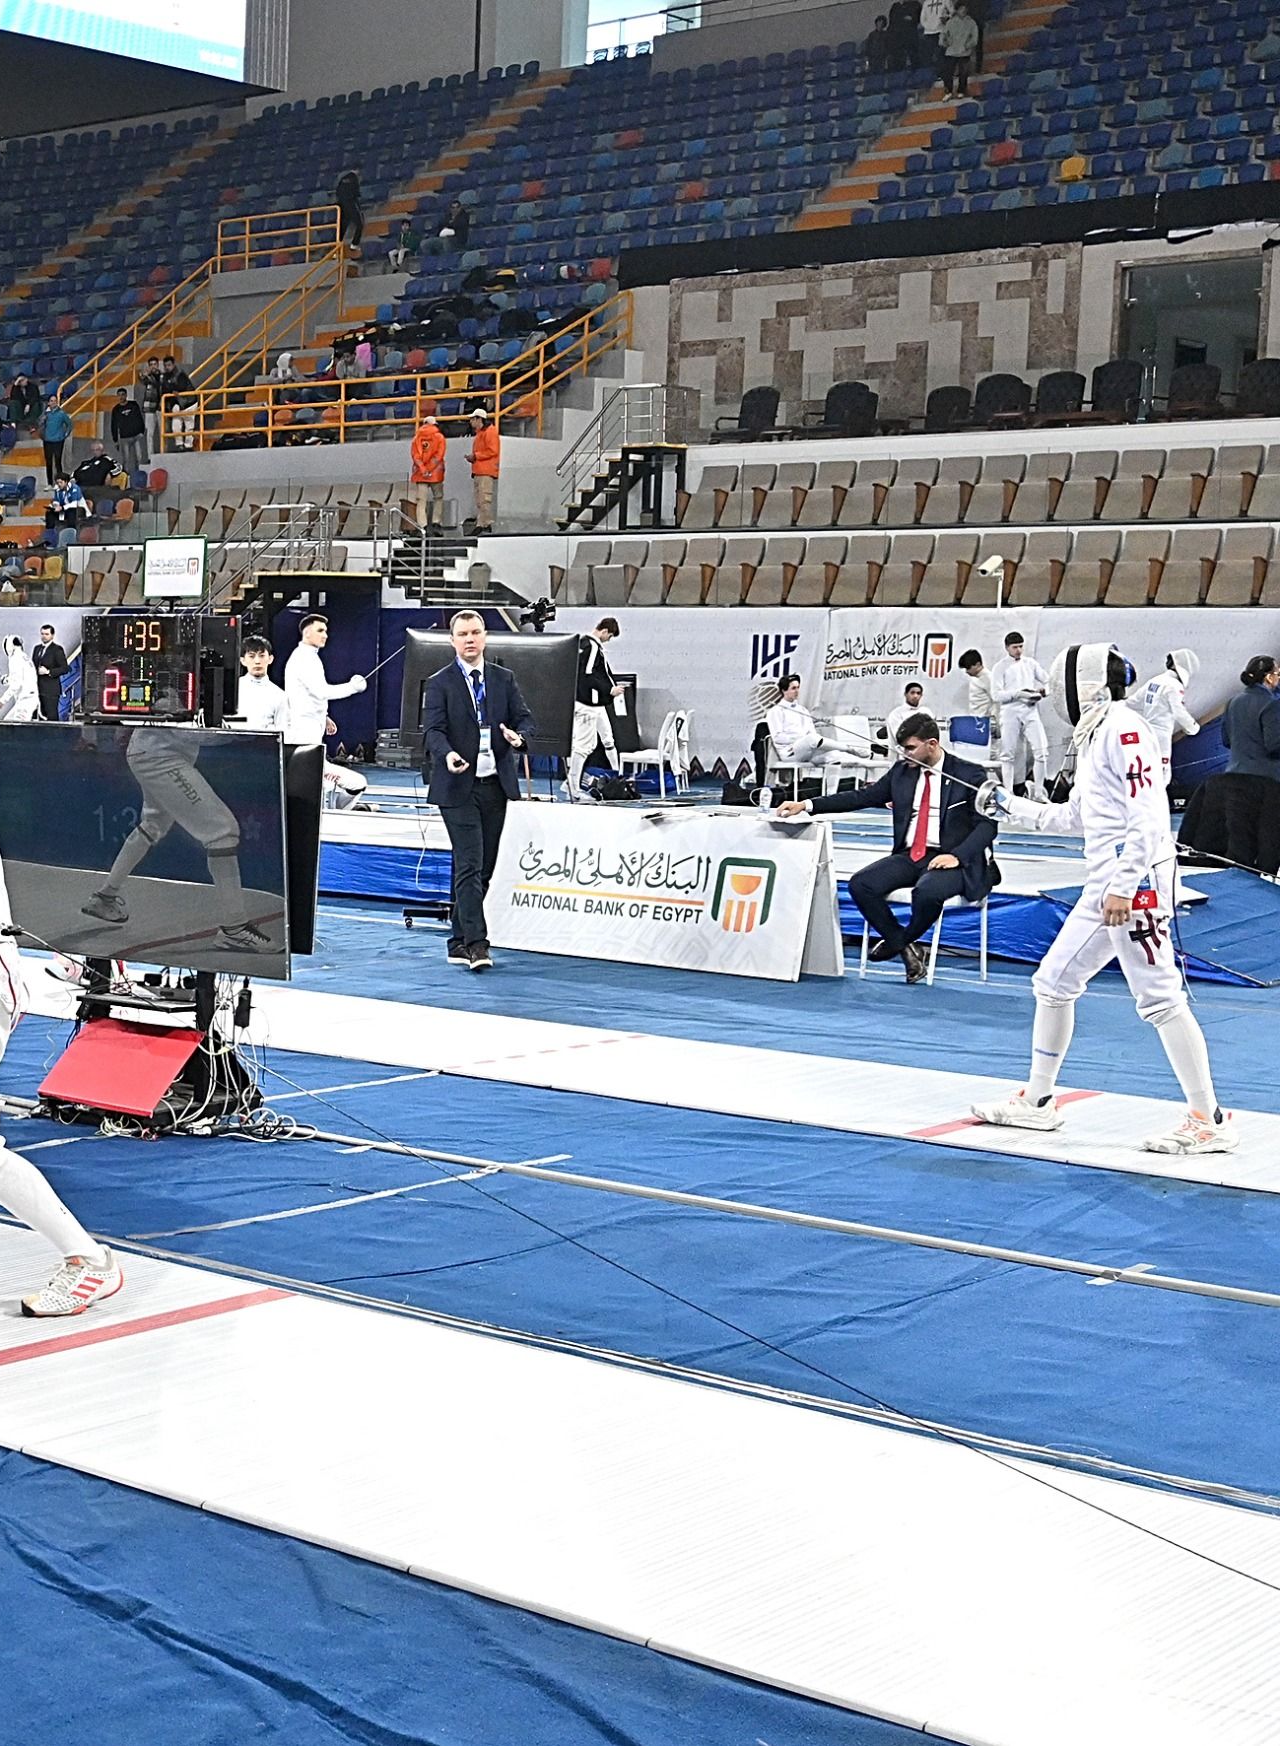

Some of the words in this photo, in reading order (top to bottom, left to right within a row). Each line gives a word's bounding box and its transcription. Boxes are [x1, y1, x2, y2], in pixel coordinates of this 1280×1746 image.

[123, 621, 161, 651] 1:35
[881, 665, 891, 674] OF
[893, 665, 918, 675] EGYPT
[103, 669, 120, 710] 2
[187, 672, 193, 710] 1
[511, 892, 578, 912] NATIONAL
[584, 899, 625, 917] BANK
[628, 903, 649, 919] OF
[652, 905, 704, 924] EGYPT
